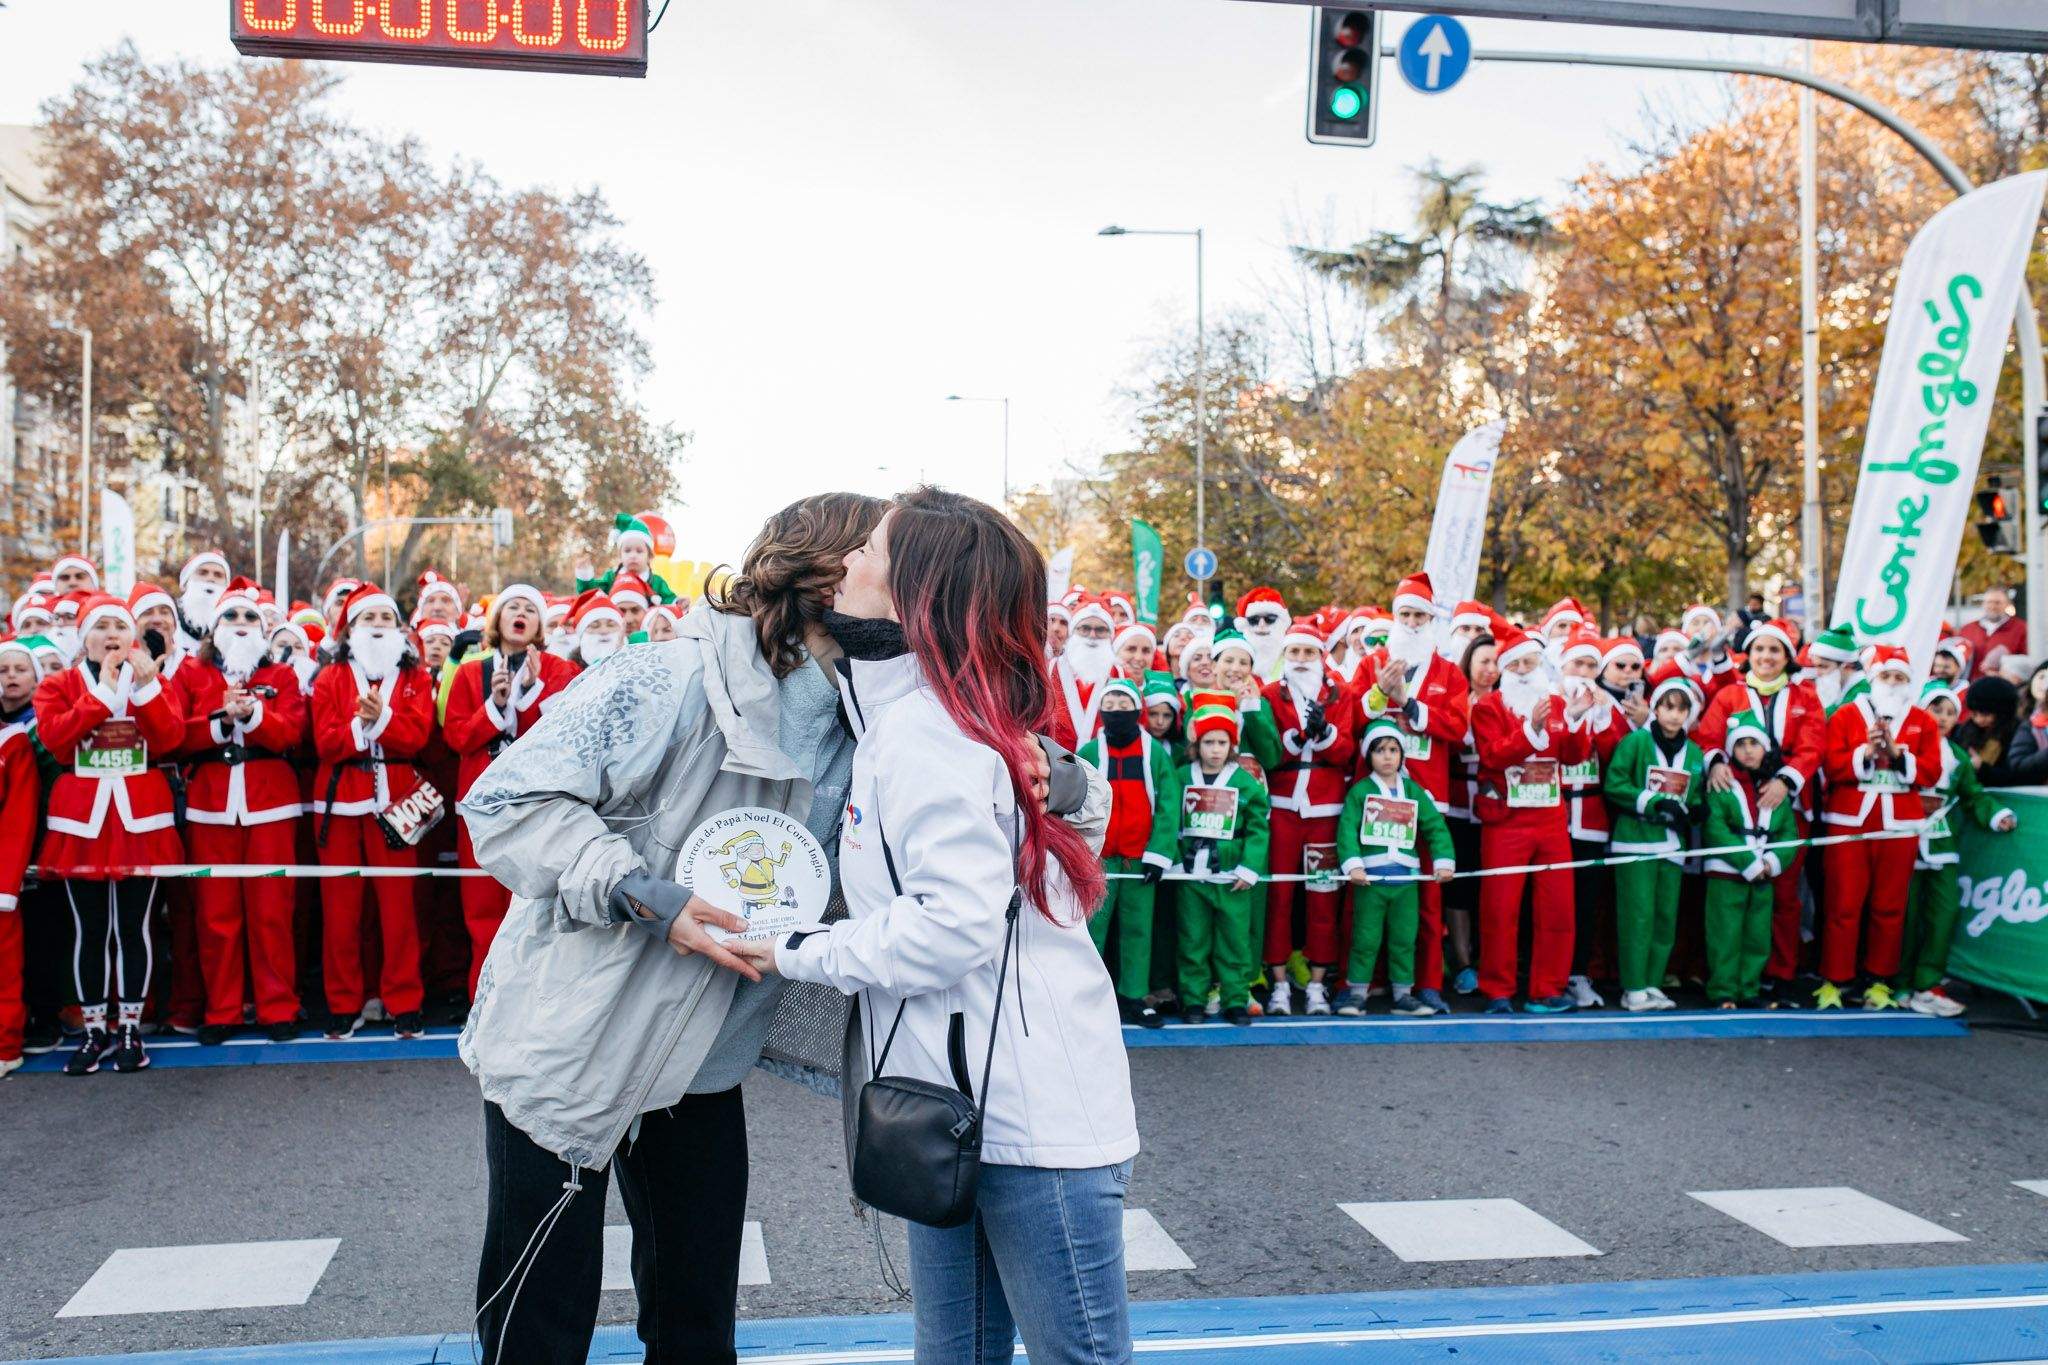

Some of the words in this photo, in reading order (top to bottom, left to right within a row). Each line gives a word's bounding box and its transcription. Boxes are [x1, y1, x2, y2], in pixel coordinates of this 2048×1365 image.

[1867, 273, 1983, 485] Inglés
[1856, 494, 1929, 635] Corte
[89, 749, 133, 768] 4456
[386, 781, 444, 844] MORE
[1190, 812, 1224, 830] 8400
[683, 837, 706, 874] Carrera
[704, 827, 715, 838] de
[715, 814, 741, 829] Papá
[744, 812, 770, 823] Noel
[772, 816, 785, 828] El
[786, 824, 810, 848] Corte
[808, 848, 824, 879] Inglés
[737, 933, 767, 942] Marta
